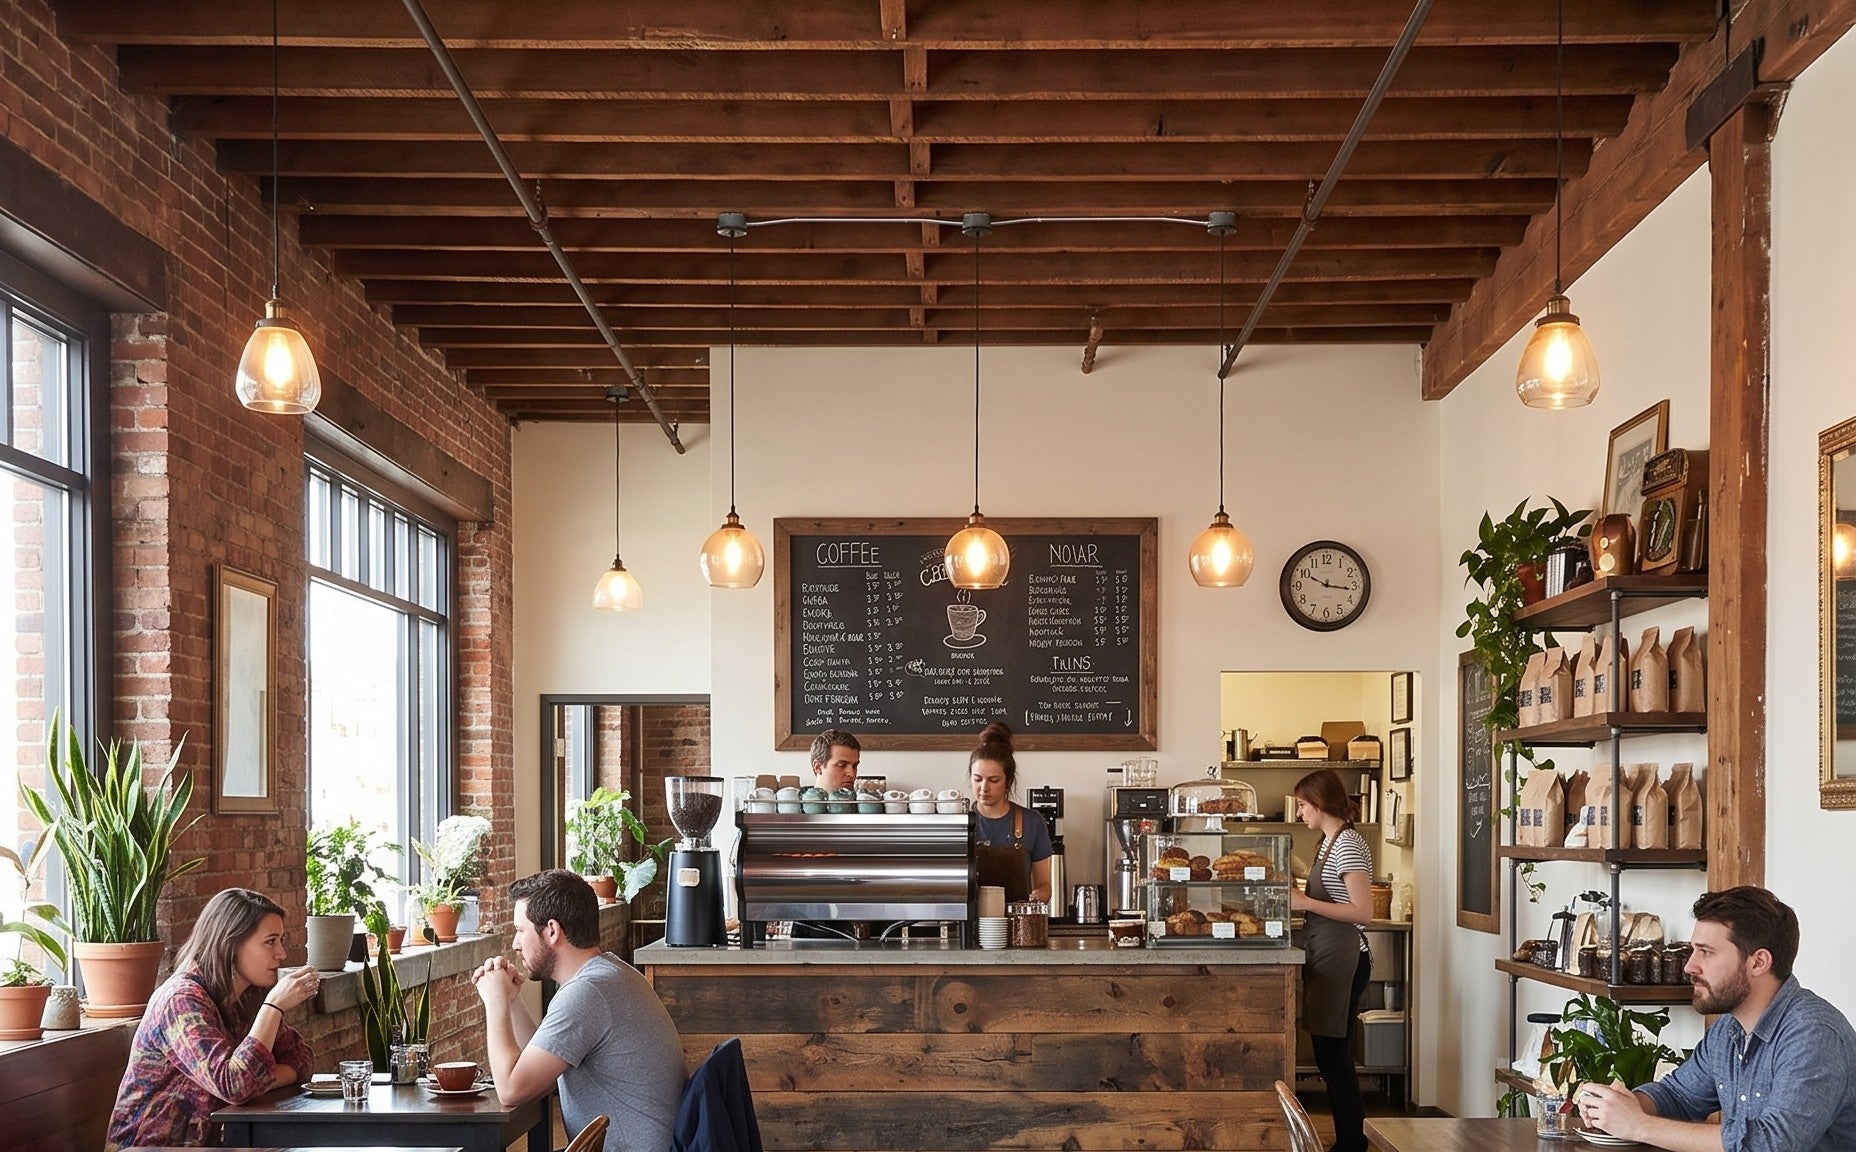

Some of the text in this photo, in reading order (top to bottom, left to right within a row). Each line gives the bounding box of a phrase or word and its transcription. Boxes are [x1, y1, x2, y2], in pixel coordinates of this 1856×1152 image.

[816, 542, 880, 565] COFFEE
[1311, 559, 1318, 568] 11
[1322, 553, 1332, 565] 12
[1300, 568, 1310, 578] 10
[1347, 567, 1353, 577] 2
[1295, 580, 1302, 591] 9
[1351, 580, 1358, 591] 3
[1300, 594, 1307, 604] 8
[1347, 595, 1353, 604] 4
[1310, 604, 1316, 616] 7
[1323, 607, 1330, 618] 6
[1336, 604, 1343, 614] 5
